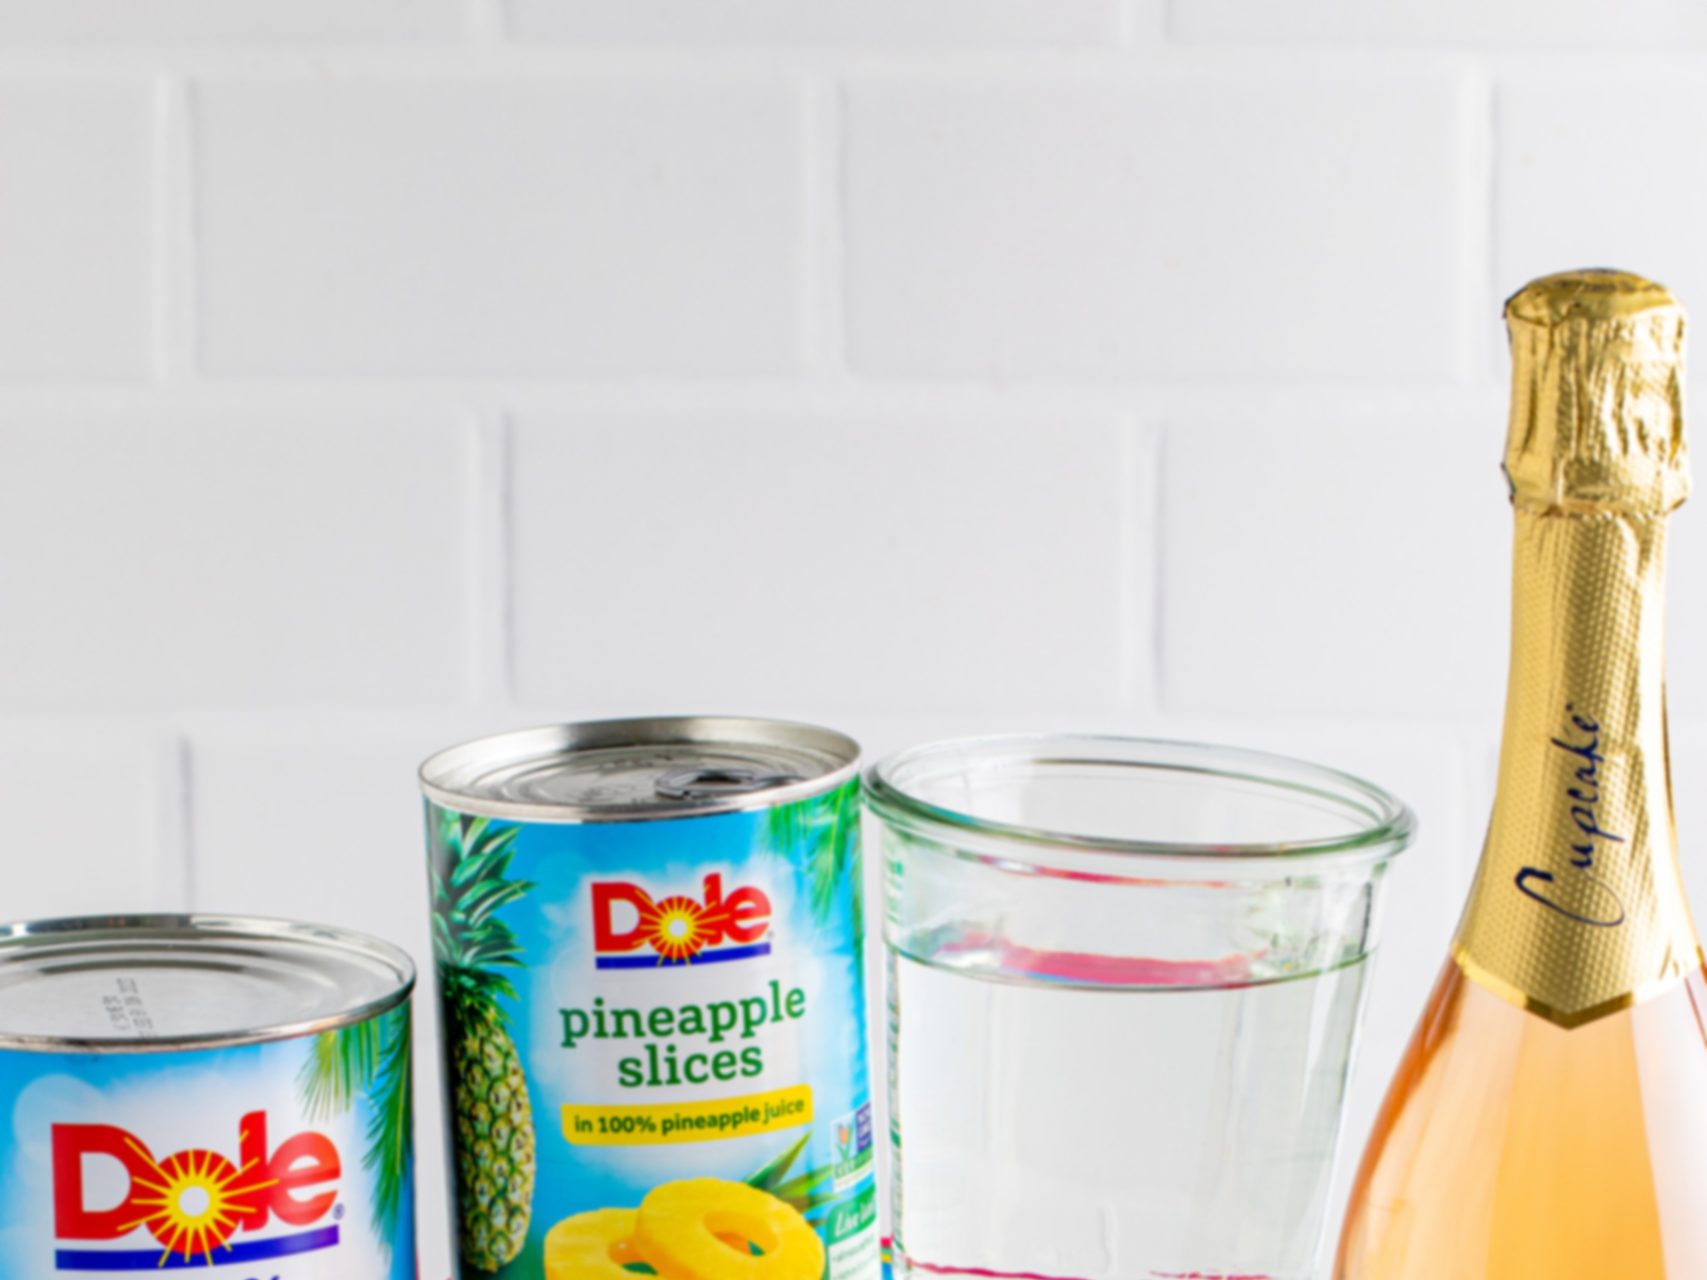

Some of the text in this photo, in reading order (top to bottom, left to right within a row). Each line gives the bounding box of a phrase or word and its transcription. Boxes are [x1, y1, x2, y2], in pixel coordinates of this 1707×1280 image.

[1515, 702, 1626, 927] Cupcake
[591, 872, 772, 959] Dole
[559, 979, 806, 1049] pineapple
[617, 1043, 764, 1088] slices
[574, 1097, 806, 1137] in 100% pineapple juice
[50, 1109, 342, 1255] Dole
